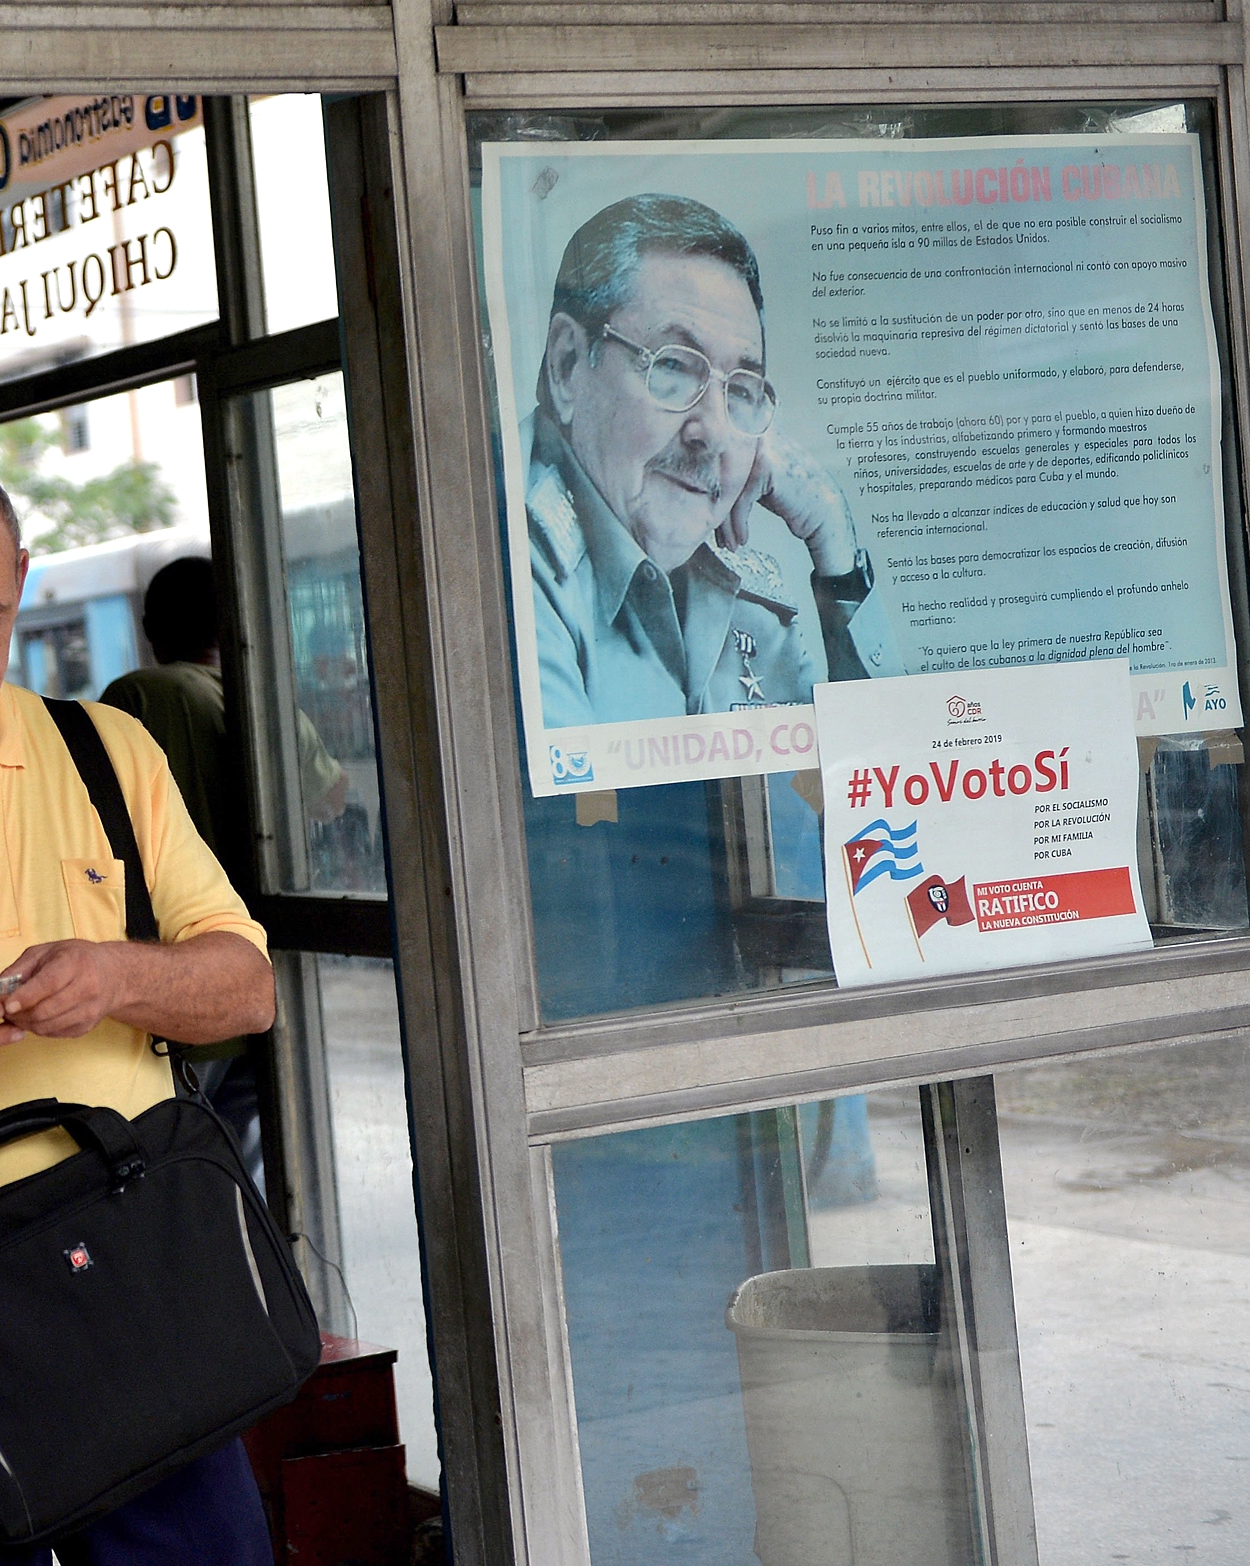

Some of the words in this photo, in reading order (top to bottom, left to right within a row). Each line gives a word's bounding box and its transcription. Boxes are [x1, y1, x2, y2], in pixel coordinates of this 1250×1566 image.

[805, 170, 845, 209] LA
[858, 158, 1051, 208] REVOLUCIÓN
[1061, 163, 1183, 202] CUBANA
[810, 224, 833, 235] Puso
[835, 223, 849, 234] fin
[860, 222, 889, 234] varios
[920, 222, 944, 232] entre
[973, 219, 983, 231] el
[985, 219, 999, 230] de
[1001, 221, 1021, 232] que
[1023, 220, 1036, 228] no
[1037, 220, 1053, 228] era
[1055, 216, 1086, 230] posible
[1088, 214, 1127, 226] construir
[1128, 213, 1138, 225] el
[1139, 213, 1182, 224] socialismo
[810, 243, 824, 251] en
[826, 242, 845, 251] una
[890, 237, 906, 249] isla
[916, 236, 930, 248] 90
[932, 236, 958, 247] millas
[959, 235, 972, 247] de
[975, 230, 1013, 246] Estados
[812, 271, 827, 282] No
[828, 270, 844, 281] fue
[846, 268, 908, 281] consecuencia
[909, 267, 922, 279] de
[923, 270, 942, 278] una
[1013, 260, 1073, 274] internacional
[1075, 260, 1084, 271] ni
[1112, 261, 1129, 270] con
[1130, 261, 1158, 271] apoyo
[1158, 257, 1187, 268] masivo
[811, 285, 826, 298] del
[868, 379, 881, 387] un
[922, 376, 940, 386] que
[942, 375, 954, 383] es
[955, 371, 965, 383] el
[967, 370, 1000, 384] pueblo
[1108, 366, 1130, 376] para
[914, 445, 977, 465] construyendo
[981, 443, 1020, 456] escuelas
[1024, 440, 1070, 456] generales
[1083, 437, 1129, 451] especiales
[1132, 438, 1153, 449] para
[1157, 433, 1181, 445] todos
[1184, 433, 1197, 443] los
[918, 476, 973, 492] preparando
[1015, 475, 1036, 486] para
[1038, 470, 1064, 482] Cuba
[1074, 469, 1083, 480] el
[914, 555, 928, 566] las
[929, 554, 956, 565] bases
[957, 554, 979, 565] para
[980, 547, 1040, 561] democratizar
[1042, 546, 1056, 556] los
[1057, 543, 1097, 557] espacios
[1098, 541, 1111, 552] de
[932, 740, 942, 748] 24
[943, 739, 953, 748] de
[955, 737, 982, 747] febrero
[984, 734, 1002, 744] 2019
[847, 747, 1070, 808] #YoVotoSí
[1034, 805, 1050, 814] POR
[1052, 804, 1061, 812] EL
[1062, 798, 1109, 811] SOCIALISMO
[1033, 821, 1050, 829] POR
[1051, 819, 1061, 828] LA
[1062, 812, 1111, 826] REVOLUCIÓN
[1033, 836, 1050, 845] POR
[1051, 835, 1061, 843] MI
[1063, 831, 1094, 842] FAMILIA
[1034, 851, 1050, 860] POR
[1051, 848, 1072, 858] CUBA
[977, 886, 989, 896] MI
[988, 883, 1011, 895] VOTO
[1011, 880, 1044, 892] CUENTA
[978, 891, 1059, 917] RATIFICO
[981, 921, 992, 930] LA
[992, 916, 1021, 929] NUEVA
[1021, 908, 1080, 925] CONSTITUCIÓN
